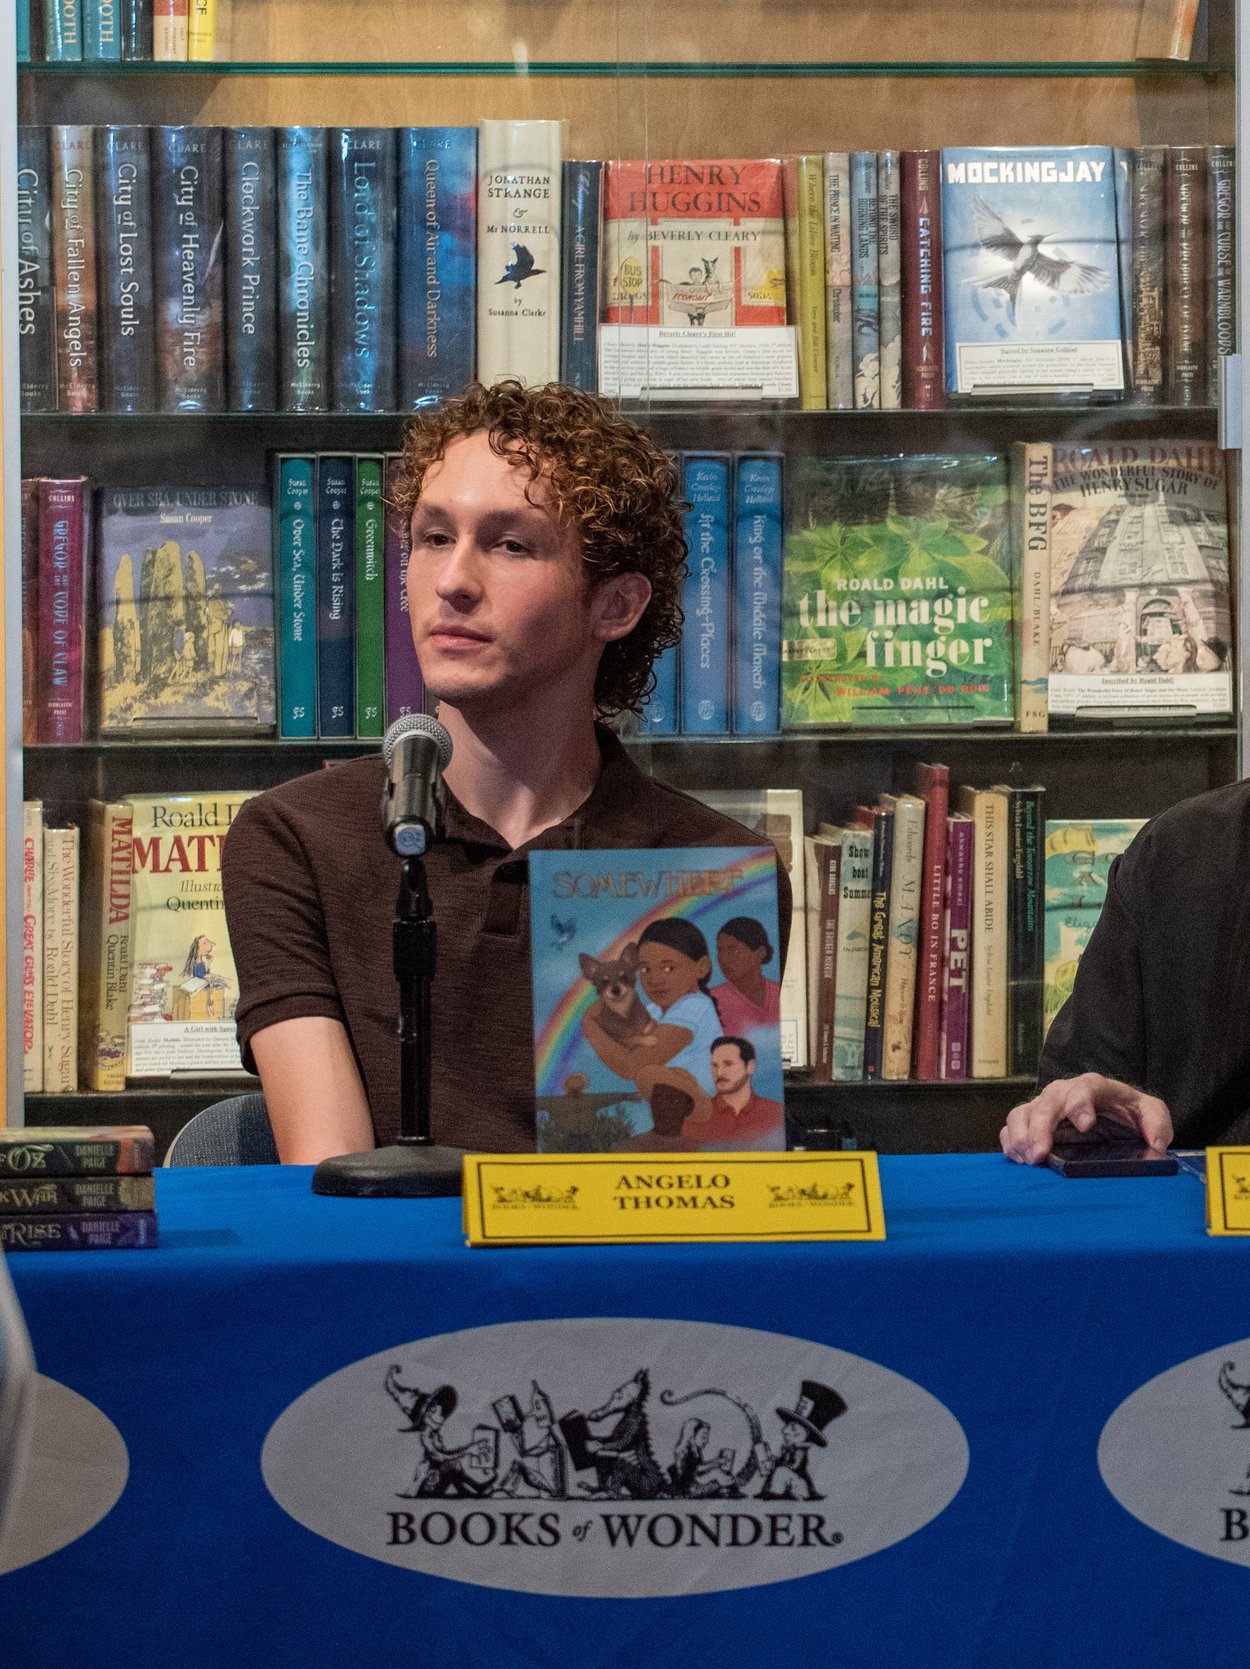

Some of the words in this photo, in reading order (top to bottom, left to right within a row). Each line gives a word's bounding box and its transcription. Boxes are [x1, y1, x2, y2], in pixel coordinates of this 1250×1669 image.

[61, 169, 83, 209] City
[113, 163, 137, 206] City
[176, 166, 199, 206] City
[296, 169, 312, 200] The
[424, 160, 439, 211] Queen
[487, 175, 551, 187] JONATHAN
[647, 164, 748, 186] HENRY
[829, 173, 840, 188] THE
[918, 158, 929, 191] COLLINS
[947, 160, 1105, 184] MOCKINGJAY
[354, 162, 376, 219] Lord
[488, 188, 551, 199] STRANGE
[628, 190, 762, 214] HUGGINS
[829, 189, 840, 215] PRINCE
[888, 193, 899, 211] THE
[1216, 179, 1232, 219] GREGOR
[241, 162, 260, 267] Clockwork
[295, 206, 313, 254] Bane
[501, 225, 550, 235] NORRELL
[647, 229, 704, 241] BEVERLY
[708, 229, 760, 241] CLEARY
[830, 224, 841, 254] WAITING
[1217, 231, 1232, 266] CURSE
[67, 239, 85, 295] Fallen
[120, 233, 139, 275] Lost
[624, 263, 643, 276] BUS
[919, 217, 932, 294] CATCHING
[18, 259, 41, 335] Ashes
[178, 234, 200, 327] Heavenly
[622, 276, 643, 289] STOP
[120, 282, 139, 336] Souls
[242, 274, 260, 335] Prince
[296, 261, 315, 368] Chronicles
[354, 255, 376, 359] Shadows
[488, 308, 519, 317] Susanna
[521, 308, 546, 317] Clarke
[920, 301, 933, 337] FIRE
[1217, 279, 1232, 355] WARMBLOODS
[64, 300, 87, 367] Angels
[426, 290, 440, 359] Darkness
[183, 332, 200, 367] Fire
[1028, 455, 1049, 496] The
[1053, 474, 1077, 492] THE
[1080, 464, 1155, 482] WONDERFUL
[1161, 467, 1199, 486] STORY
[1078, 477, 1131, 498] HENRY
[1132, 476, 1189, 496] SUGAR
[112, 490, 145, 508] OVER
[175, 490, 217, 507] UNDER
[219, 489, 260, 506] STONE
[159, 512, 184, 524] Susan
[185, 512, 213, 525] Cooper
[292, 518, 305, 547] Over
[1027, 503, 1048, 552] BFG
[53, 520, 69, 568] GREGOR
[331, 541, 344, 570] Dark
[836, 578, 895, 592] ROALD
[900, 577, 949, 590] DAHL
[329, 585, 344, 621] Rising
[799, 589, 862, 628] the
[874, 586, 990, 635] magic
[293, 612, 306, 642] Stone
[52, 652, 68, 687] CLAW
[865, 629, 993, 679] finger
[835, 686, 891, 697] WILLIAM
[938, 685, 956, 695] DU
[961, 684, 990, 694] BOIS
[151, 803, 219, 829] Roald
[985, 803, 995, 829] THIS
[24, 837, 35, 884] CHARLIE
[984, 830, 995, 858] STAR
[108, 815, 133, 926] MATILDA
[550, 868, 743, 900] SOMEWHERE
[852, 866, 869, 879] boat
[931, 865, 942, 908] LITTLE
[984, 860, 995, 897] SHALL
[61, 865, 75, 937] Wonderful
[873, 891, 887, 909] The
[984, 899, 995, 933] ABIDE
[23, 914, 36, 952] GREAT
[871, 911, 886, 942] Great
[930, 913, 940, 930] BO
[46, 946, 58, 982] Roald
[60, 939, 75, 974] Story
[106, 934, 119, 980] Quentin
[119, 934, 129, 963] Roald
[869, 943, 884, 986] American
[950, 928, 968, 993] PET
[24, 955, 35, 987] GLASS
[928, 953, 938, 1002] FRANCE
[24, 989, 35, 1055] ELEVATOR
[46, 991, 58, 1026] Dahl
[58, 998, 73, 1042] Henry
[866, 989, 882, 1028] Mousical
[615, 1173, 731, 1190] ANGELO
[613, 1195, 736, 1210] THOMAS
[386, 1511, 561, 1547] BOOKS
[571, 1519, 593, 1541] of
